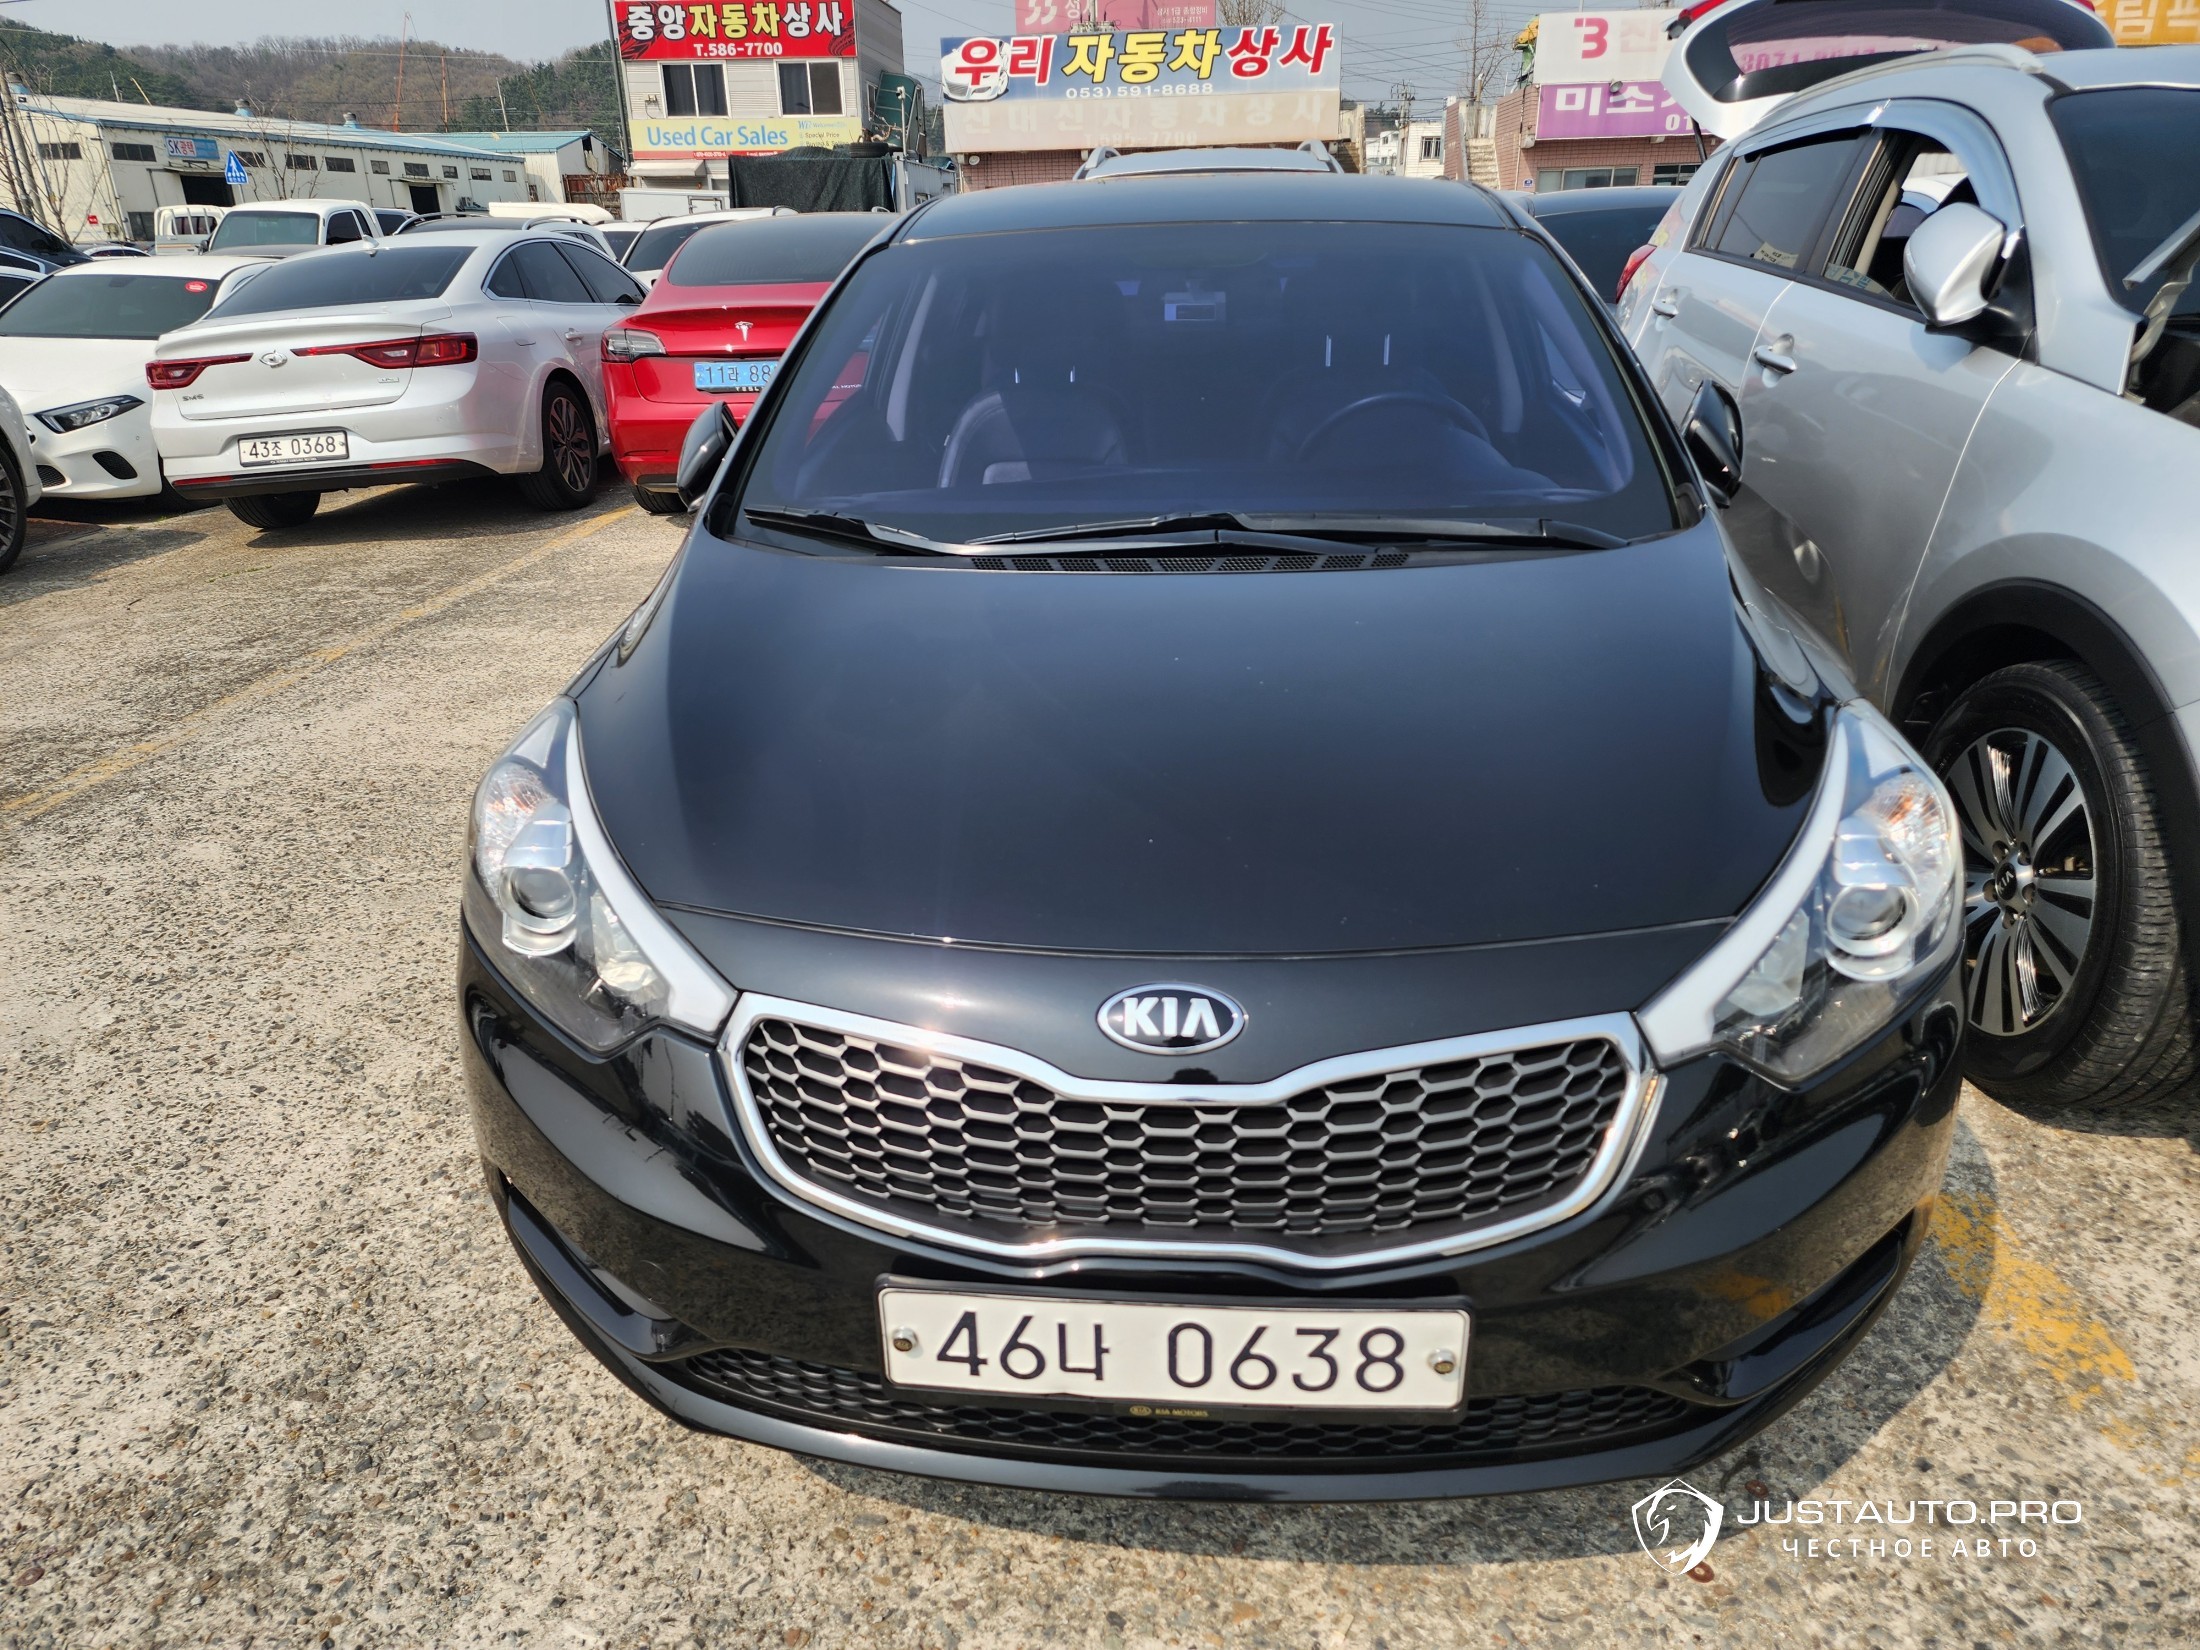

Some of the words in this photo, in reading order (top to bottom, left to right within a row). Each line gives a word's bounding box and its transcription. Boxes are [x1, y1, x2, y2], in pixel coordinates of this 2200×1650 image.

[693, 42, 783, 57] T.586-7700
[1665, 113, 1694, 131] 01
[646, 126, 696, 146] Used
[700, 126, 734, 146] Car
[738, 125, 788, 145] Sales
[705, 365, 739, 384] 11라
[750, 365, 776, 383] 88
[249, 441, 283, 459] 43조
[291, 436, 336, 455] 0368
[1122, 996, 1221, 1038] KIA
[936, 1311, 1111, 1382] 46나
[1167, 1321, 1406, 1393] 0638
[1172, 1408, 1208, 1417] MOTORS
